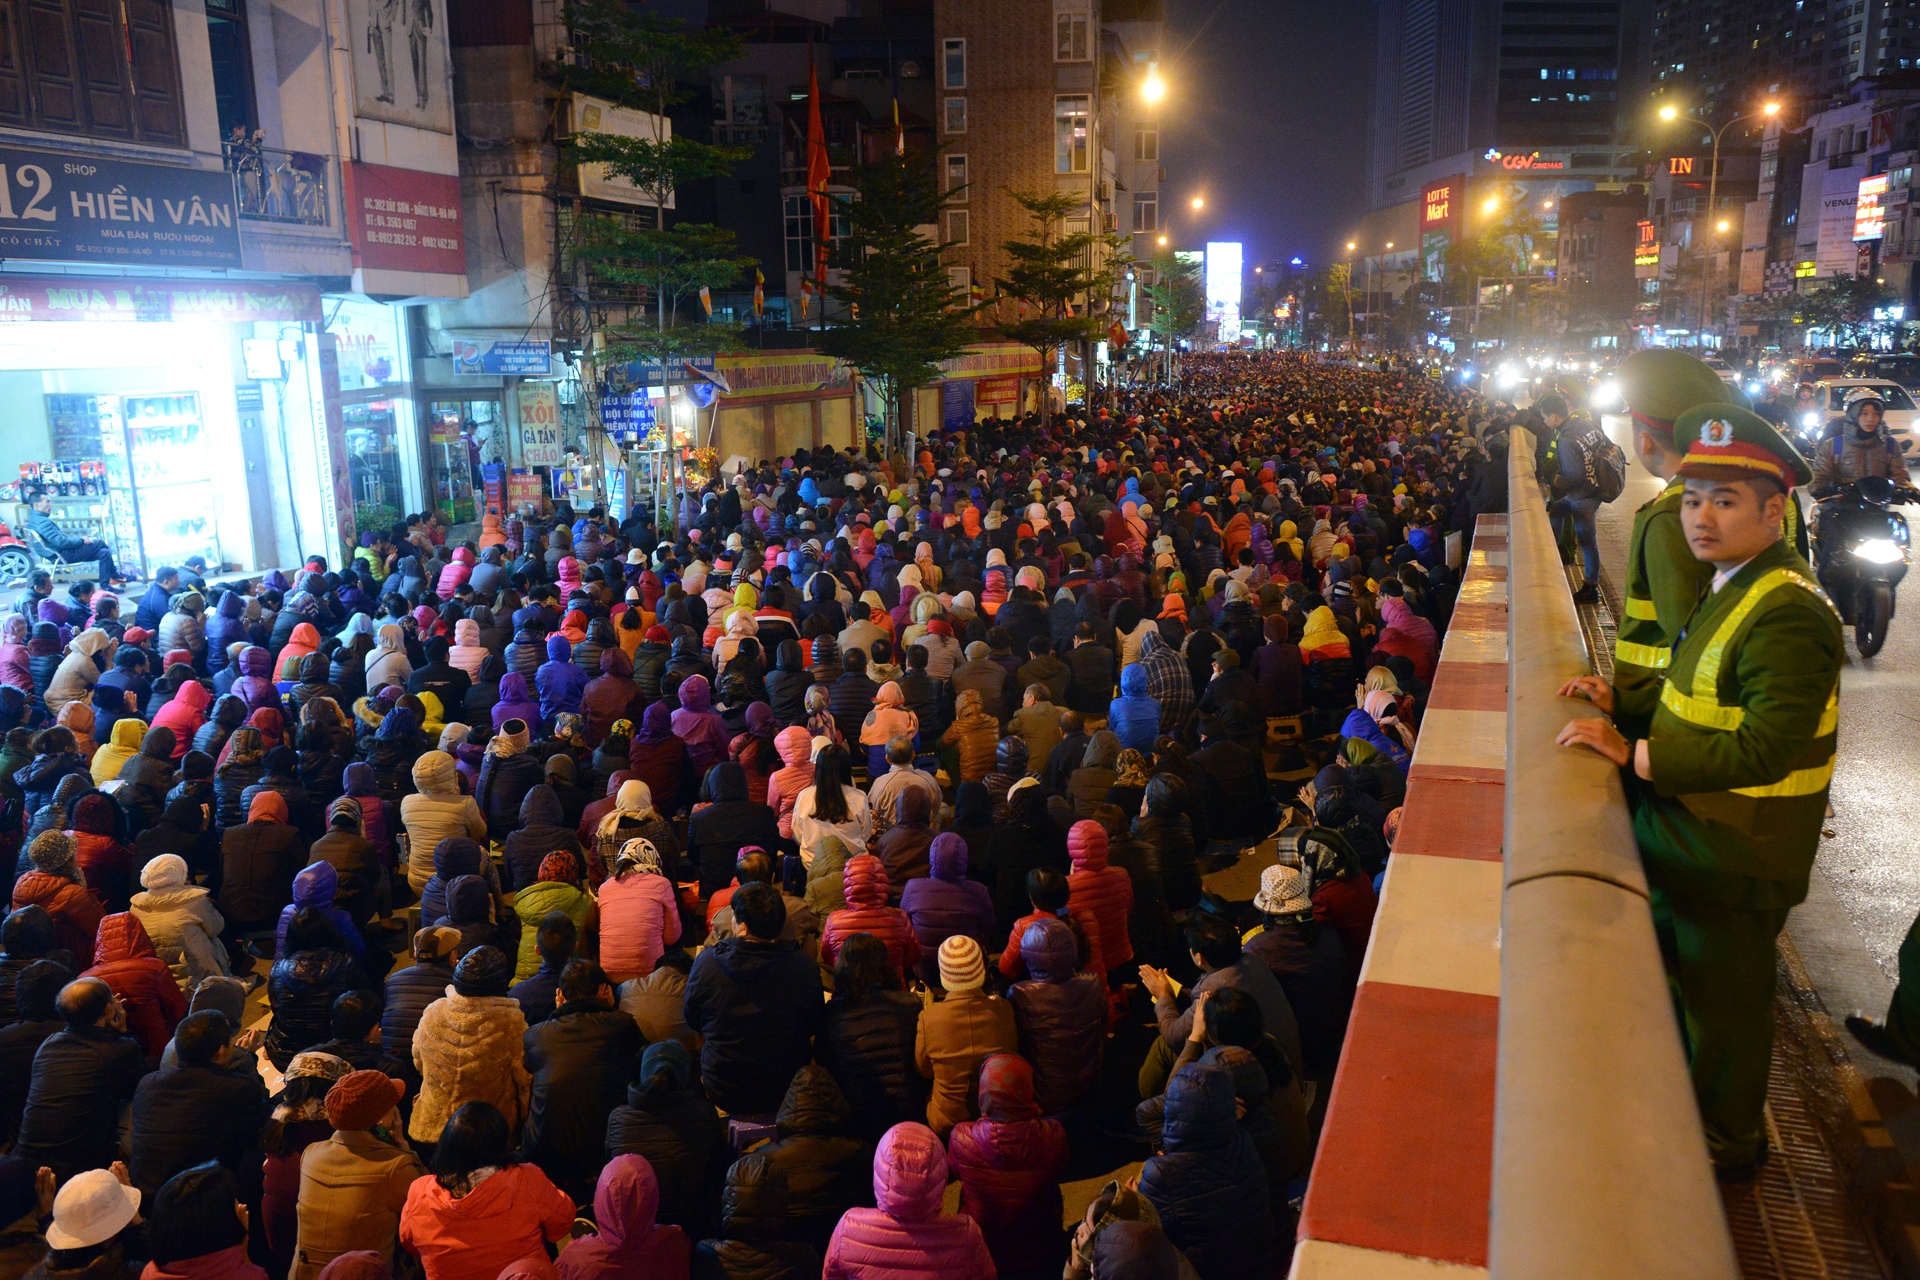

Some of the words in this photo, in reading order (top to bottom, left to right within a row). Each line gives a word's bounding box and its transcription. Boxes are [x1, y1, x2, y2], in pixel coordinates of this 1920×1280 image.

[64, 163, 97, 176] SHOP
[1503, 155, 1533, 169] CGV
[1670, 158, 1693, 174] IN
[1427, 187, 1449, 203] LOTTE
[70, 184, 155, 223] HIỀN
[163, 195, 232, 228] VÂN
[1427, 201, 1449, 221] Mart
[101, 229, 125, 239] MUA
[127, 230, 149, 240] BÁN
[154, 231, 182, 243] RƯỢU
[184, 234, 215, 244] NGOẠI
[1641, 226, 1654, 242] IN
[47, 288, 111, 311] MUA
[114, 285, 170, 312] BÁN
[172, 288, 237, 312] RƯỢU
[522, 399, 554, 423] XÔI
[606, 409, 620, 420] HỘI
[316, 400, 326, 442] VESTON
[629, 421, 638, 431] KỲ
[524, 427, 536, 443] GÀ
[526, 445, 557, 462] CHÁO
[510, 485, 522, 496] SIM
